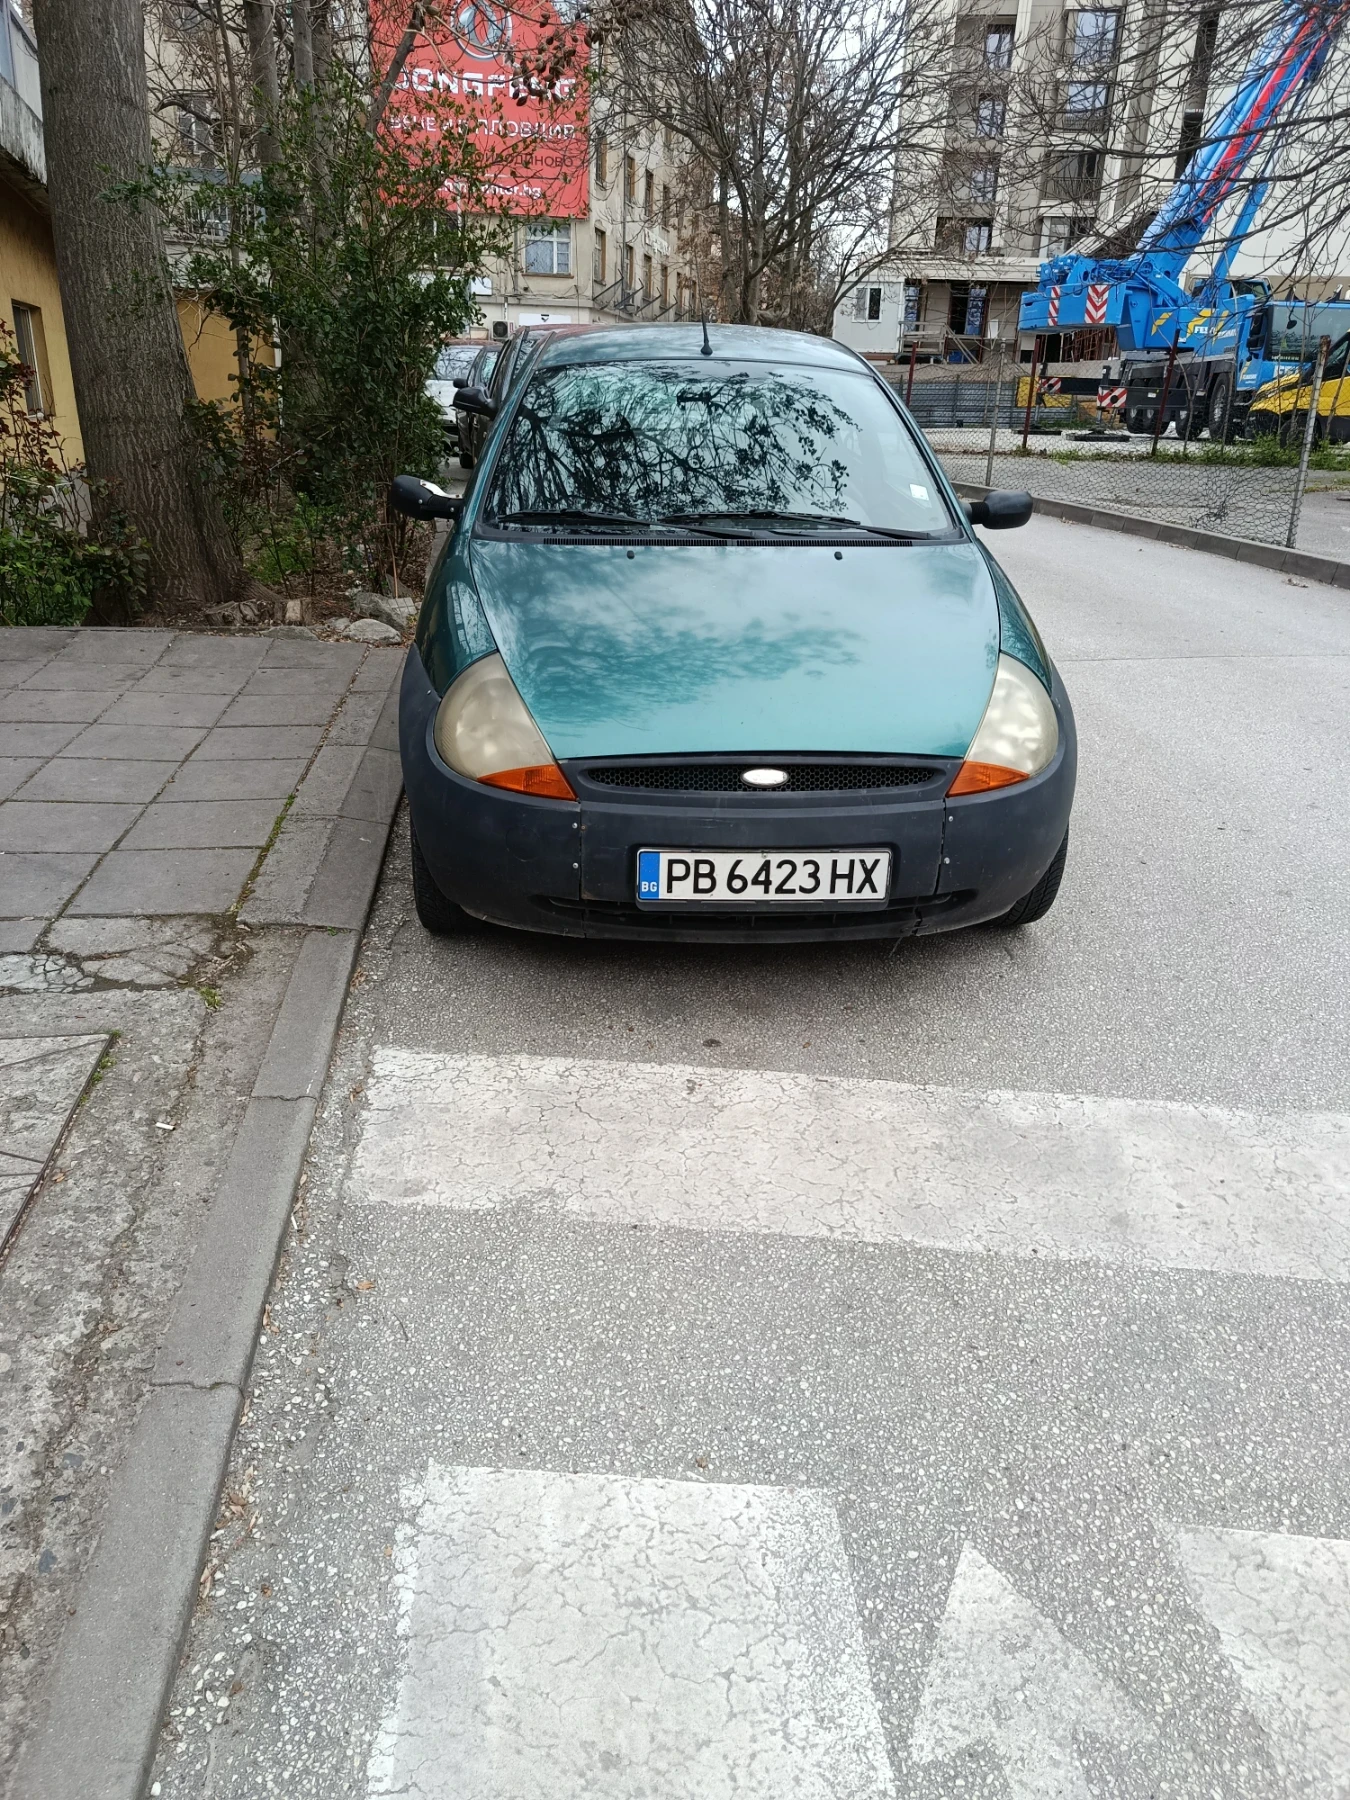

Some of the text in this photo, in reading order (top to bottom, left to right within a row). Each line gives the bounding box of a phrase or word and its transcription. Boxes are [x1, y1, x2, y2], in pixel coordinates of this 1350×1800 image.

[475, 118, 576, 141] ПЛОВДИВ
[641, 858, 881, 895] BG PB 6423 HX
